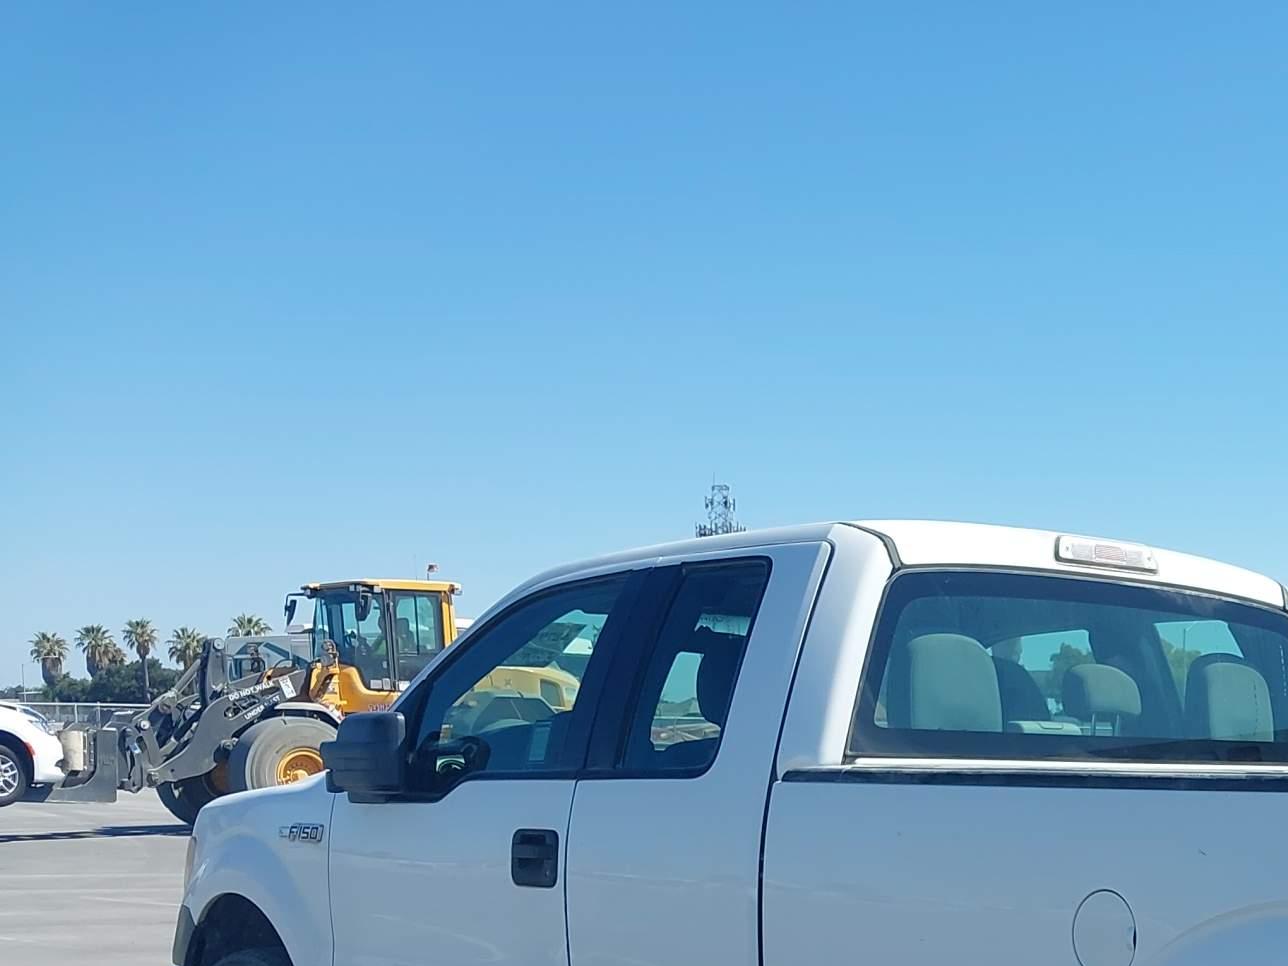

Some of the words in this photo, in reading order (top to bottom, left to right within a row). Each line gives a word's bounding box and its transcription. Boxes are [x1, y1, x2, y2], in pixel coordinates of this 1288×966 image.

[228, 691, 240, 701] DO
[240, 686, 255, 697] NOT
[244, 704, 265, 719] UNDER
